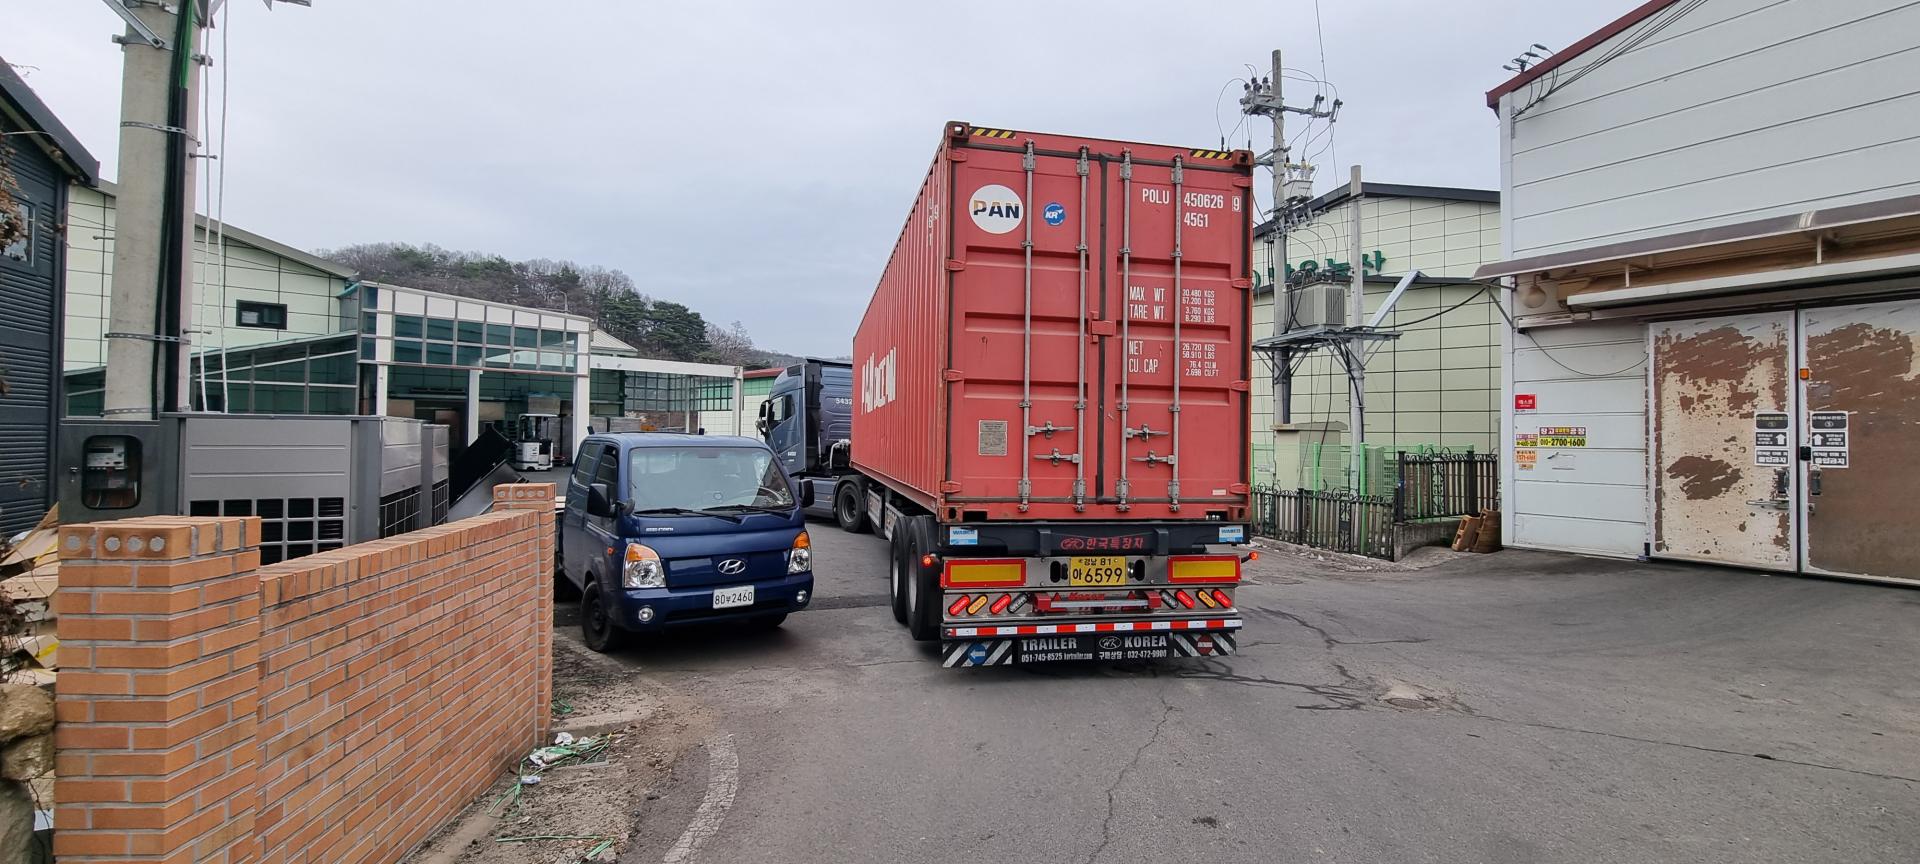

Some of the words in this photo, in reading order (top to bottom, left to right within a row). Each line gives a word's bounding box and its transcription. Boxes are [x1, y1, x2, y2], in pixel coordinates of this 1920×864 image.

[1142, 188, 1170, 205] POLU
[1184, 192, 1224, 209] 450626
[1233, 197, 1240, 211] 9
[973, 199, 1020, 219] PAN
[1184, 212, 1209, 228] 45G1
[1204, 290, 1215, 298] KGS
[1204, 298, 1215, 306] LBS
[1129, 304, 1148, 319] TARE
[1204, 308, 1215, 316] KGS
[1204, 315, 1215, 323] LBS
[1129, 341, 1143, 355] NET
[1182, 343, 1202, 352] 26.720
[1204, 344, 1215, 352] KGS
[1182, 351, 1202, 359] 58.910
[1204, 352, 1215, 360] LBS
[1021, 637, 1077, 651] TRAILER
[1124, 636, 1167, 648] KOREA
[1021, 652, 1063, 663] 051-745-8525
